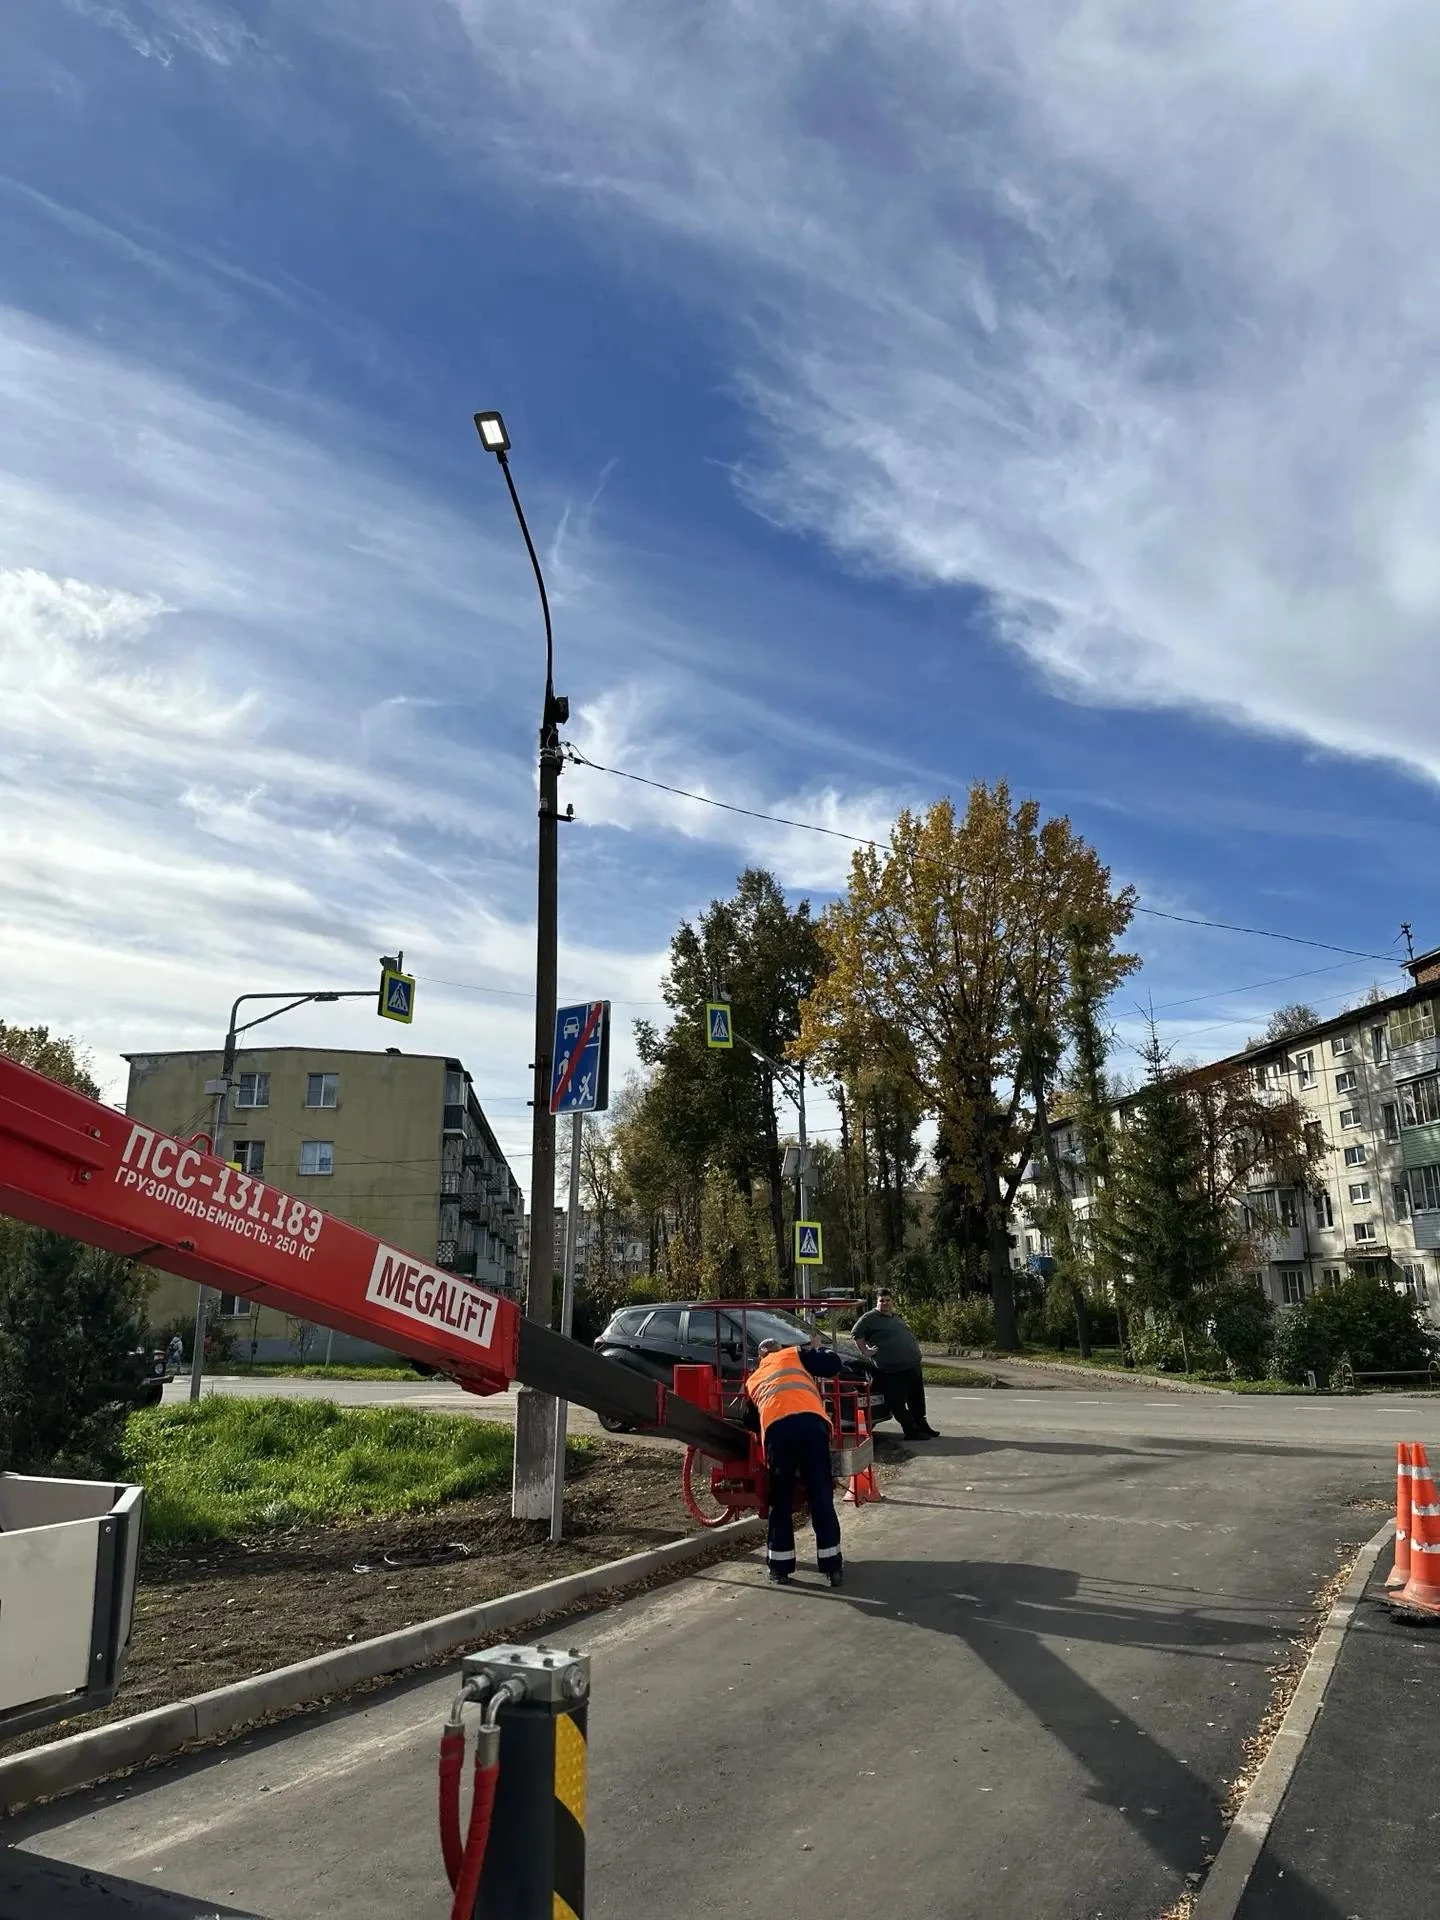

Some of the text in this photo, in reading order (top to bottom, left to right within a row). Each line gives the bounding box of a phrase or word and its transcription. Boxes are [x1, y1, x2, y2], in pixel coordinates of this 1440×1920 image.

[114, 1166, 316, 1262] ГРУЗОПОДЪЕМНОСТЬ: 250 КГ
[376, 1255, 492, 1338] MEGALIFT
